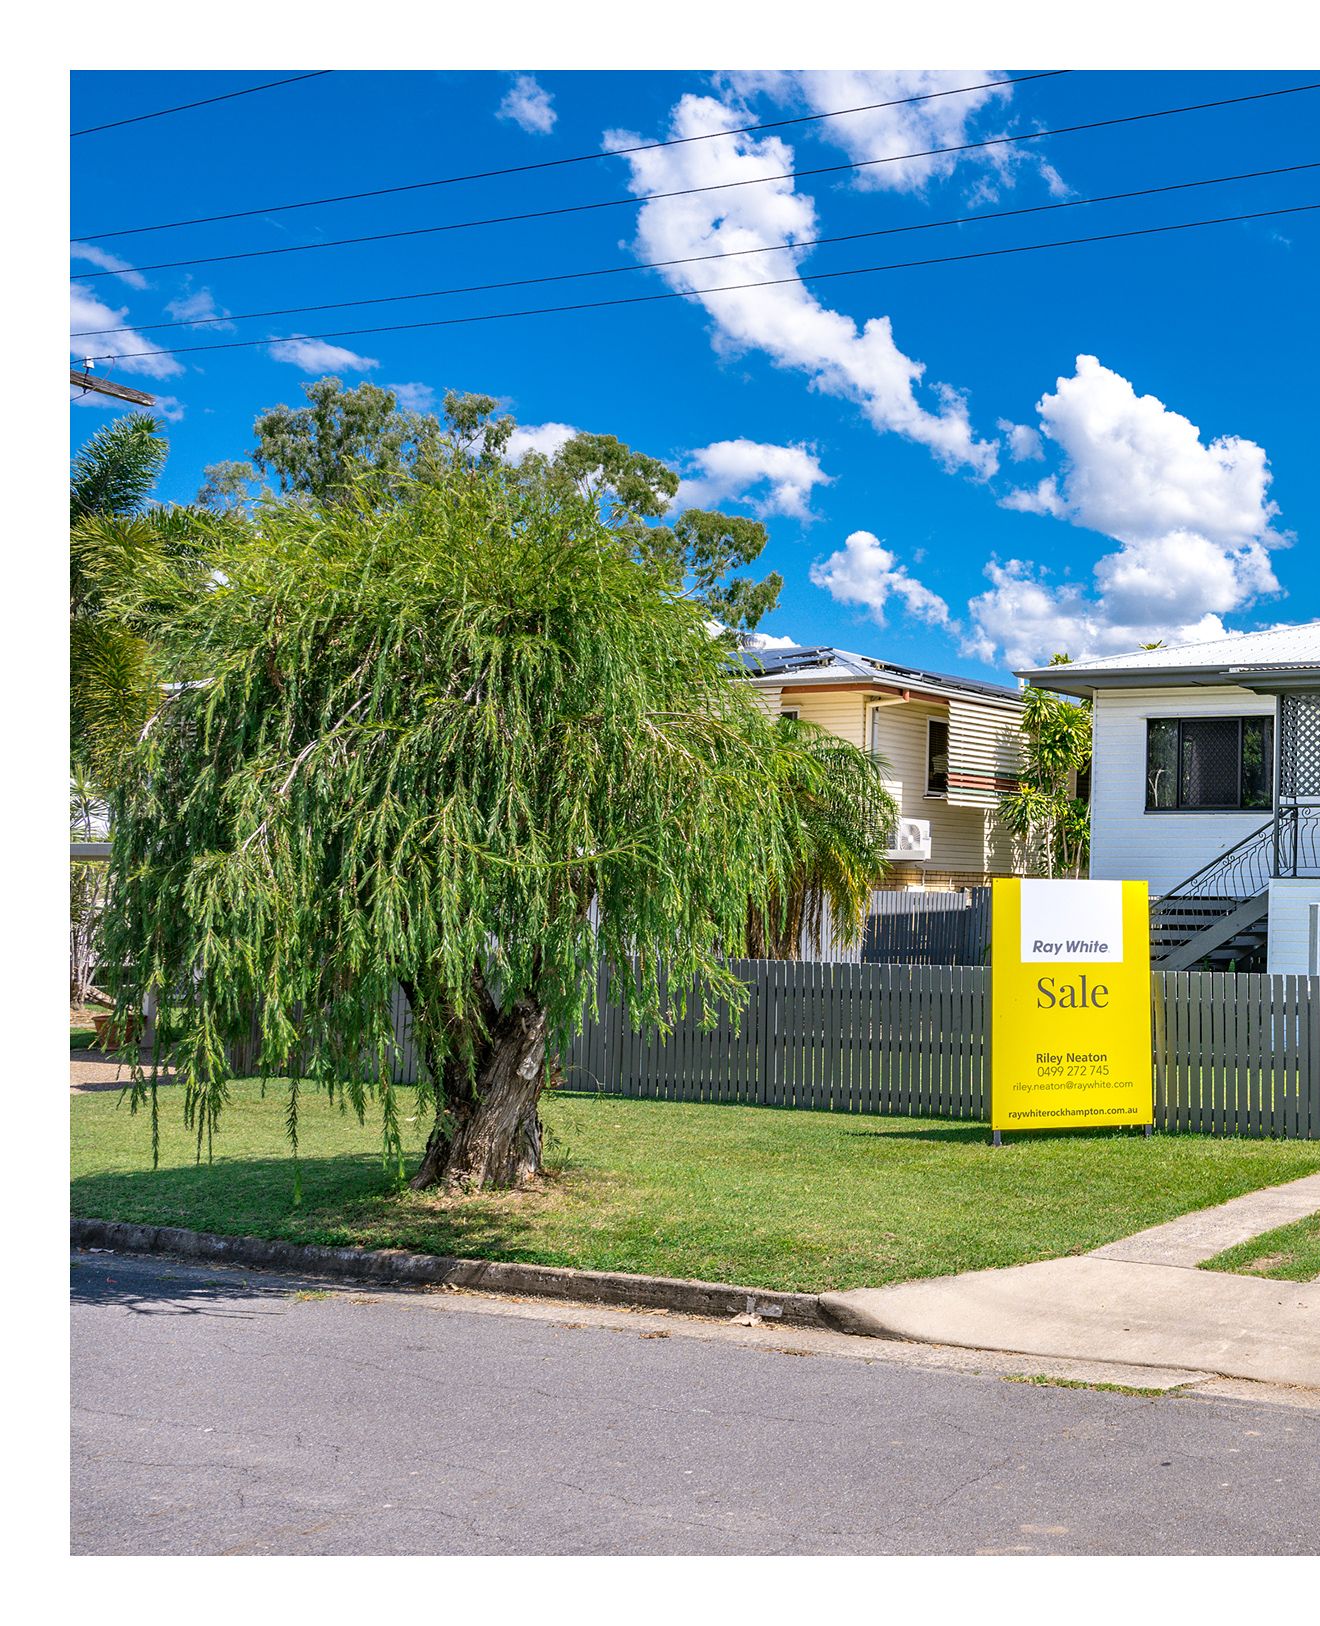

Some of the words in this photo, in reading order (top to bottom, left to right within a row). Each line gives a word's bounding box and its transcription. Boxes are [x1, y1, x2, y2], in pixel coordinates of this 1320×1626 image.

[1032, 940, 1062, 955] Ray
[1066, 940, 1109, 953] White
[1037, 975, 1109, 1009] Sale
[1036, 1053, 1063, 1065] Riley
[1066, 1052, 1107, 1063] Neaton
[1037, 1066, 1064, 1077] 0499
[1067, 1066, 1087, 1076] 272
[1090, 1065, 1109, 1076] 745
[1012, 1080, 1133, 1093] riley.neaton@raywhite.com
[1008, 1106, 1138, 1119] raywhiterockhampton.com.au
